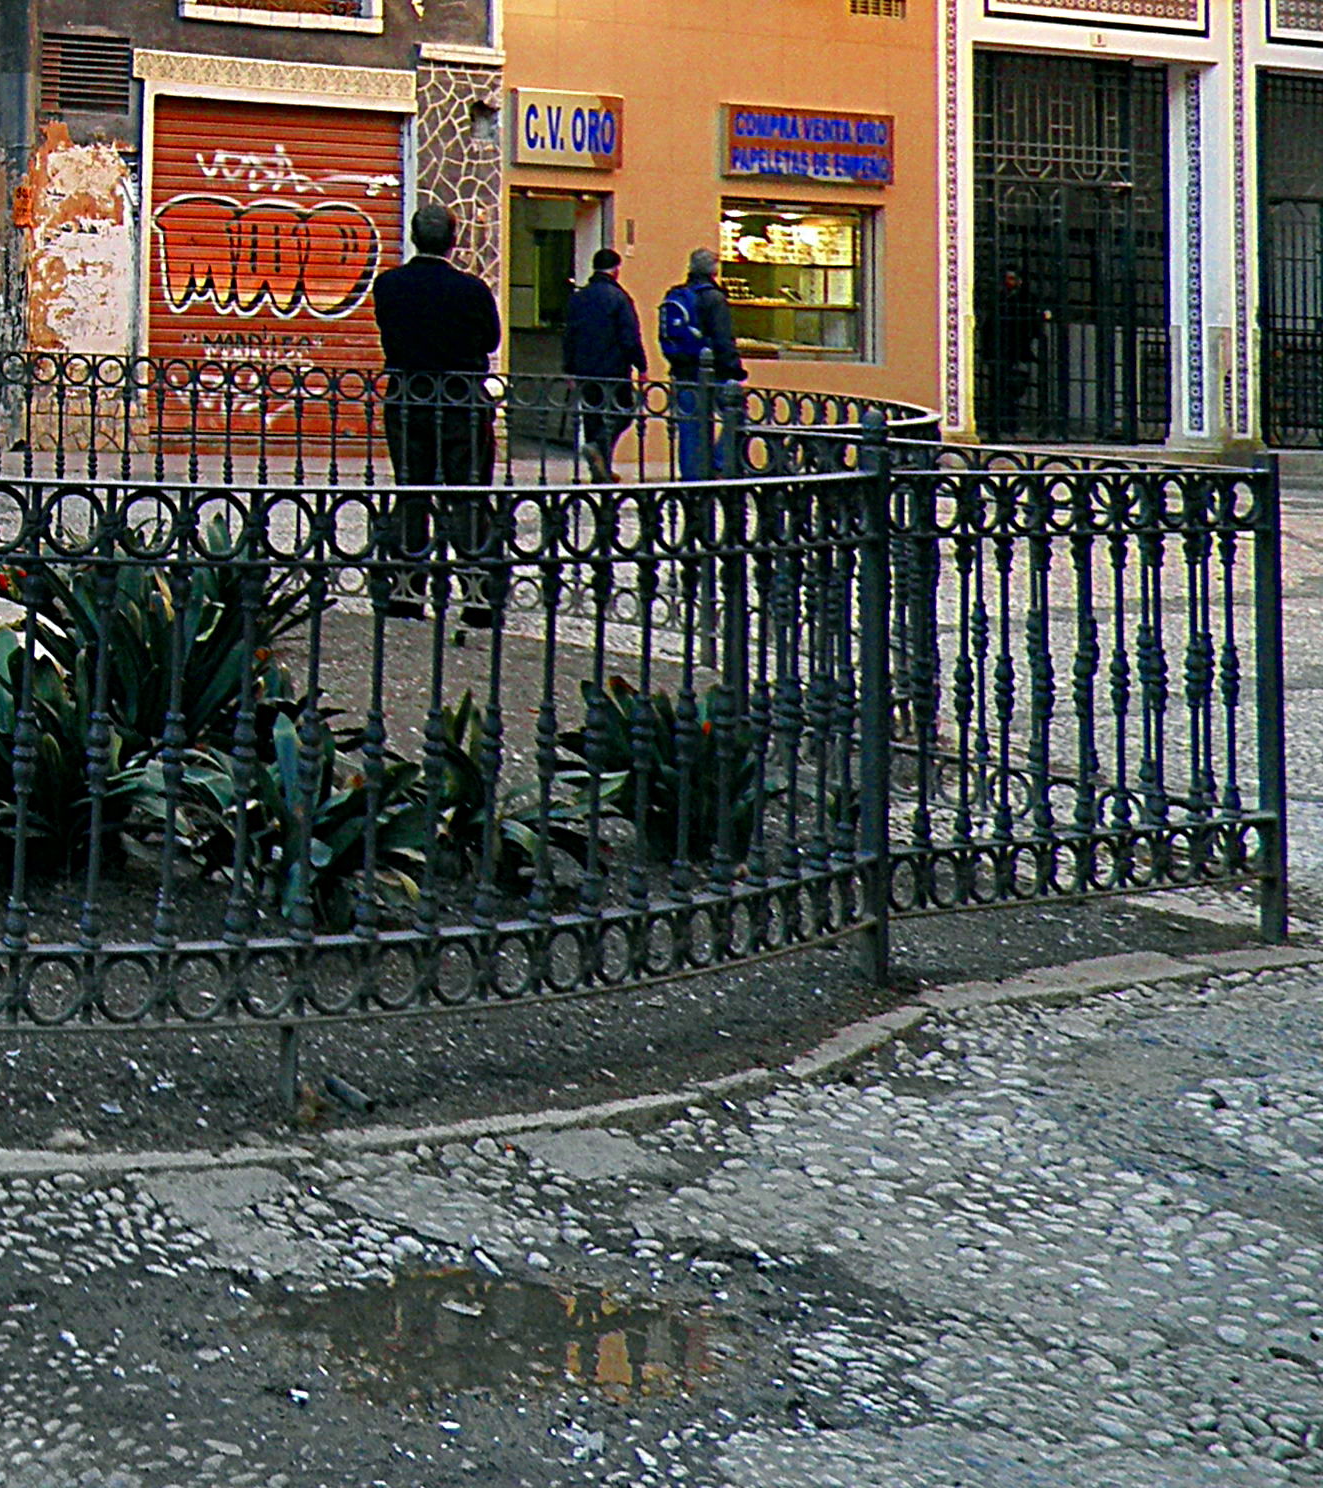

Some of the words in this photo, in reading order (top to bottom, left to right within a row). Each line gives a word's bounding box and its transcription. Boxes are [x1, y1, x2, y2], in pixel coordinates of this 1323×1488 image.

[524, 102, 565, 151] C.V.
[571, 106, 616, 155] ORO
[734, 112, 800, 140] COMPRA
[804, 117, 853, 143] VENTA
[856, 120, 888, 147] ORO
[731, 146, 809, 176] PAPELETAS
[812, 151, 831, 177] DE
